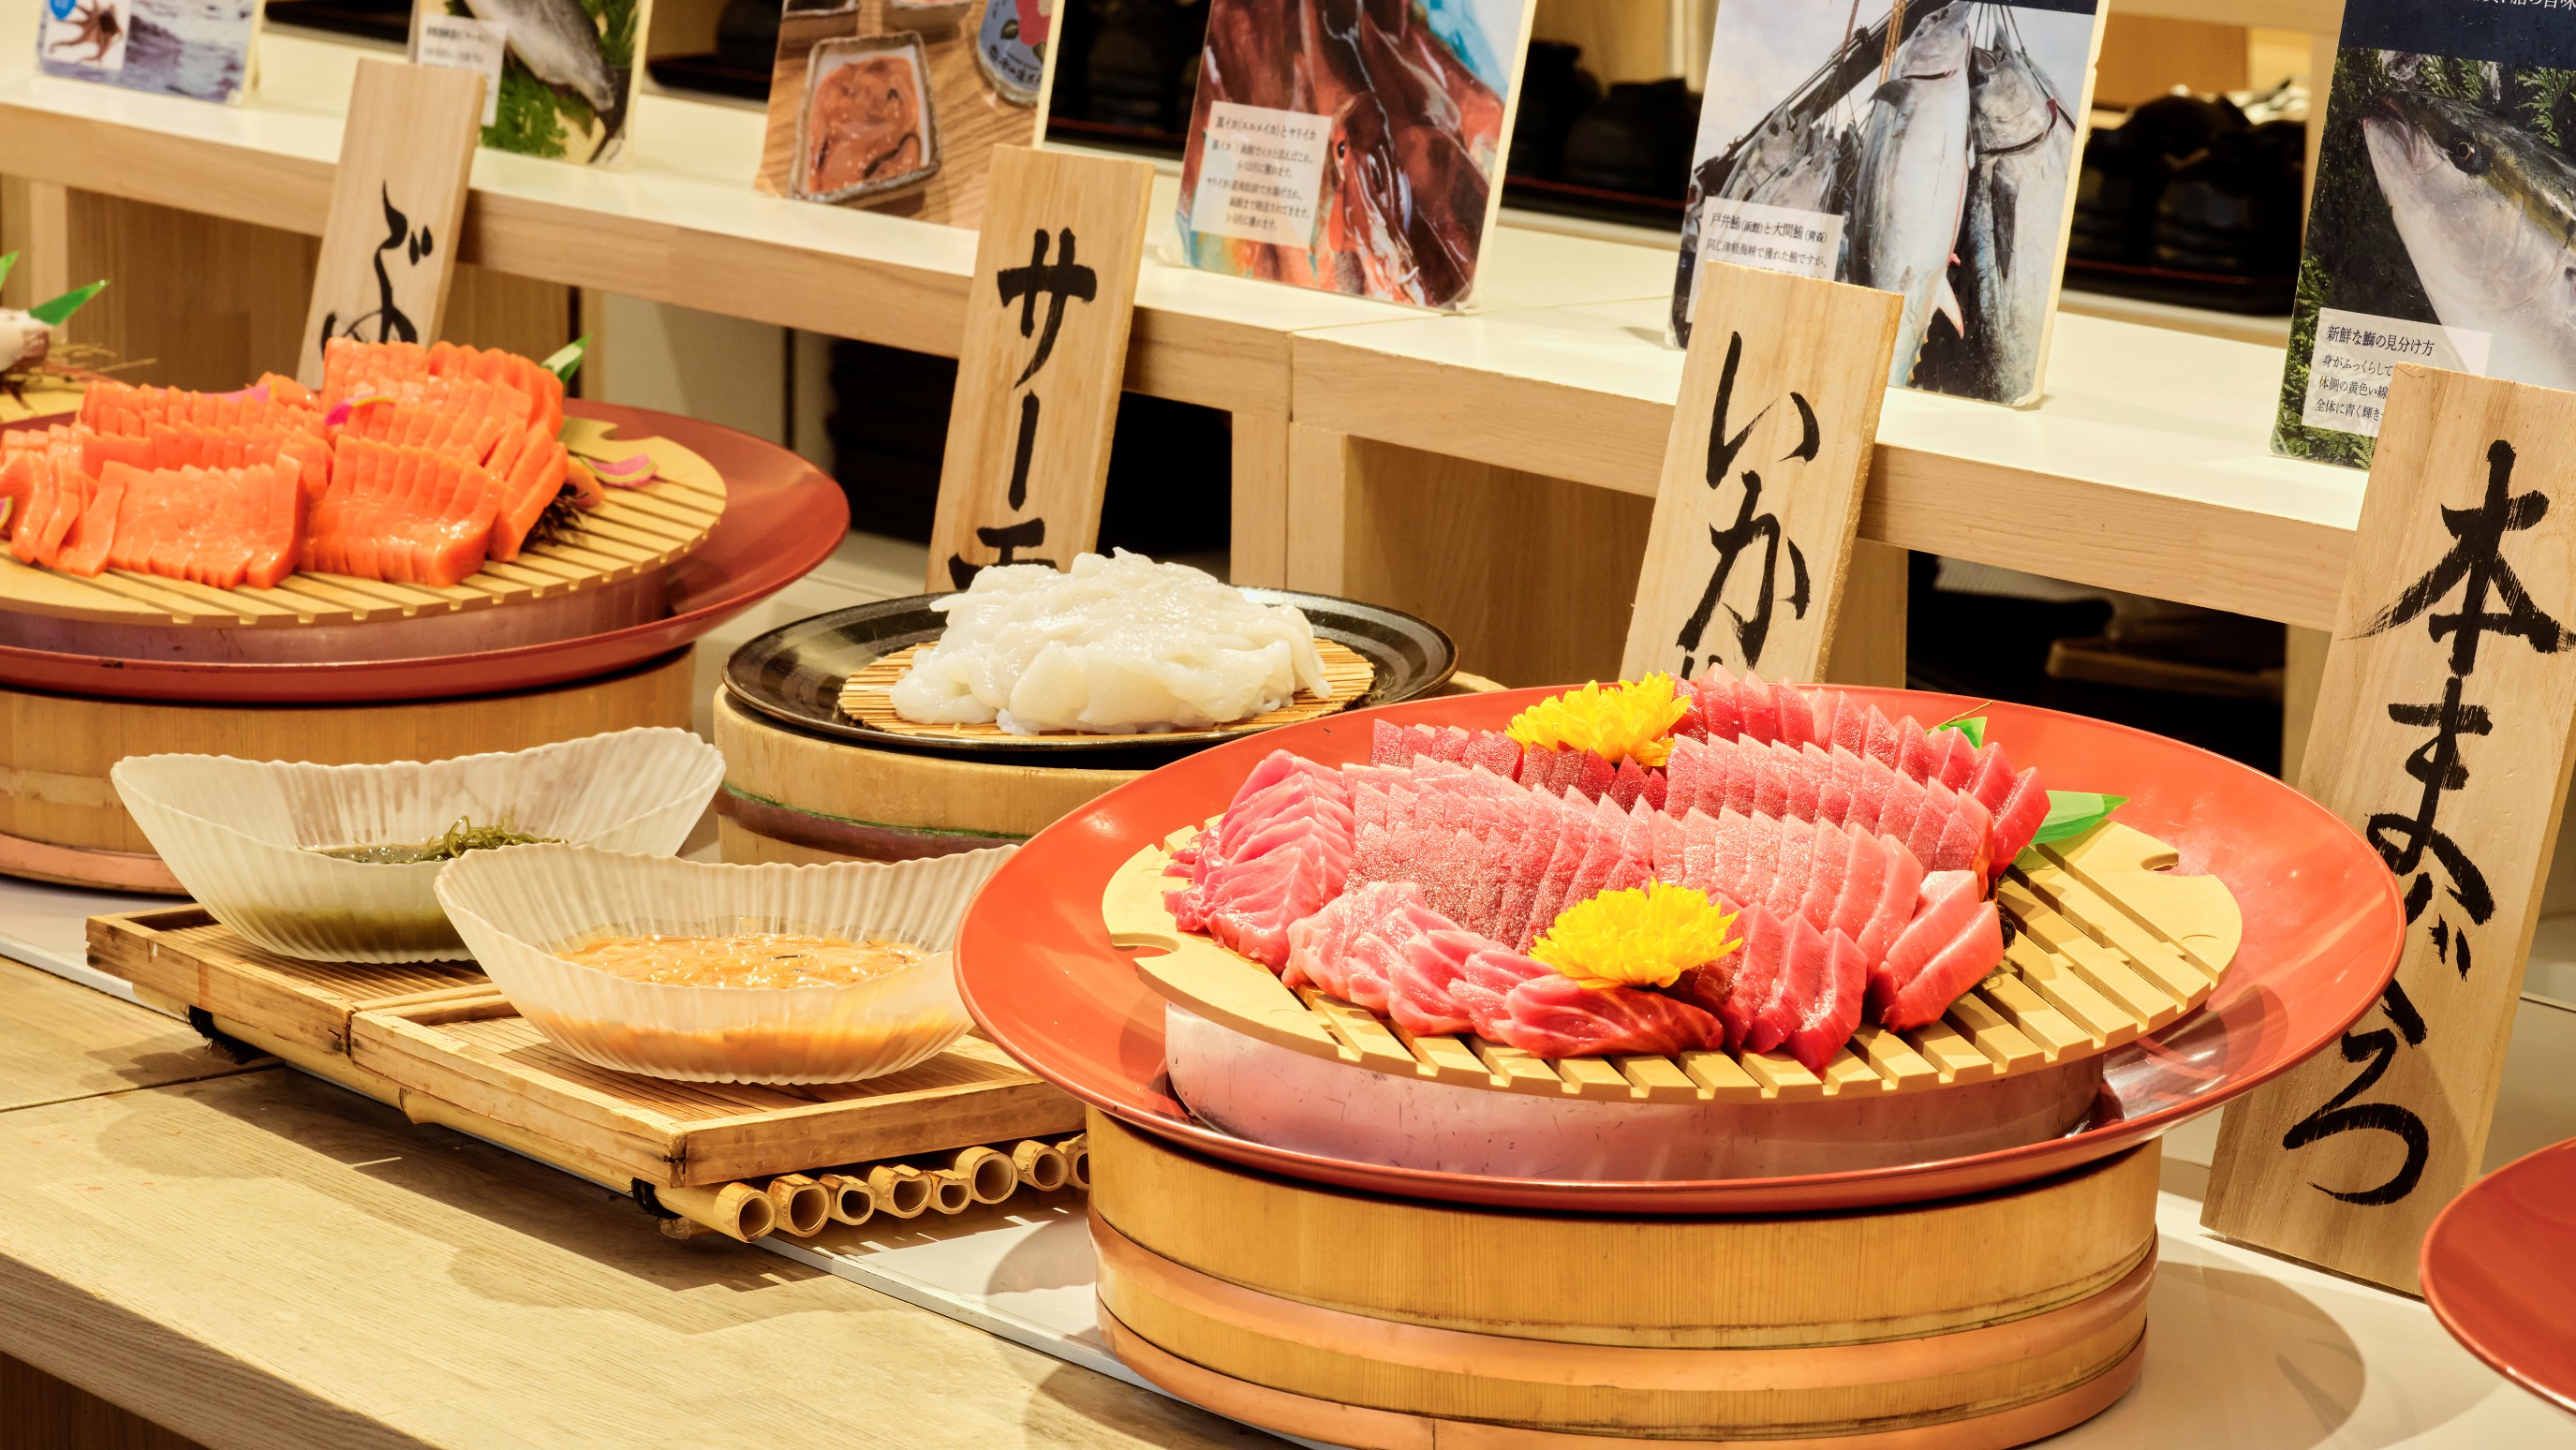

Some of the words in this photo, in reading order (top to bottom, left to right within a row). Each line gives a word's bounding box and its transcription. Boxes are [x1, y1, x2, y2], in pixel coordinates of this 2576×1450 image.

[2327, 325, 2435, 356] 新鮮な鰤の見分け方
[2323, 354, 2393, 377] 身がふっくらして
[2284, 439, 2576, 1206] 本まぐろ
